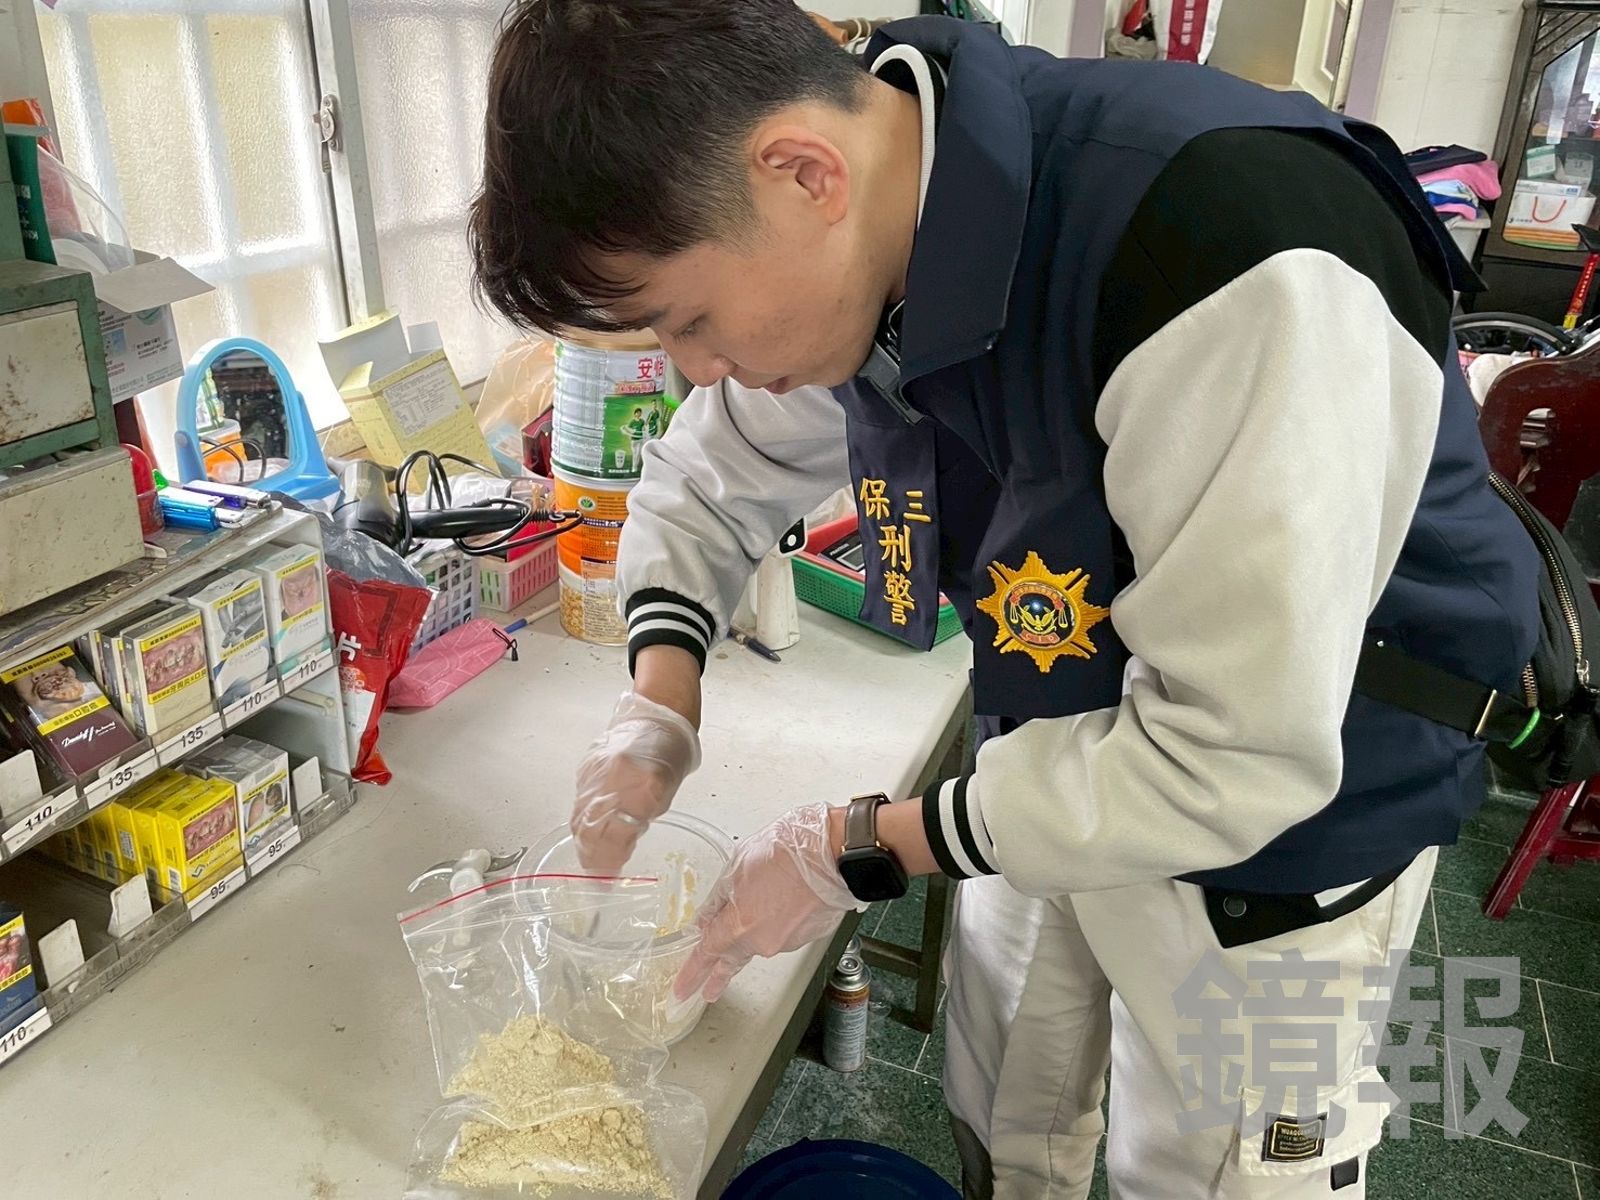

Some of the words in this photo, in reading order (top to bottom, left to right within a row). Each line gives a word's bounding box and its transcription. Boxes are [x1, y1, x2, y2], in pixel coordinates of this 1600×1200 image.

[300, 659, 317, 679] 110
[243, 691, 262, 712] 110
[181, 725, 204, 748] 135
[108, 766, 132, 790] 135
[25, 805, 52, 831] 110
[268, 839, 283, 858] 95
[210, 881, 226, 899] 95
[0, 1026, 27, 1052] 110
